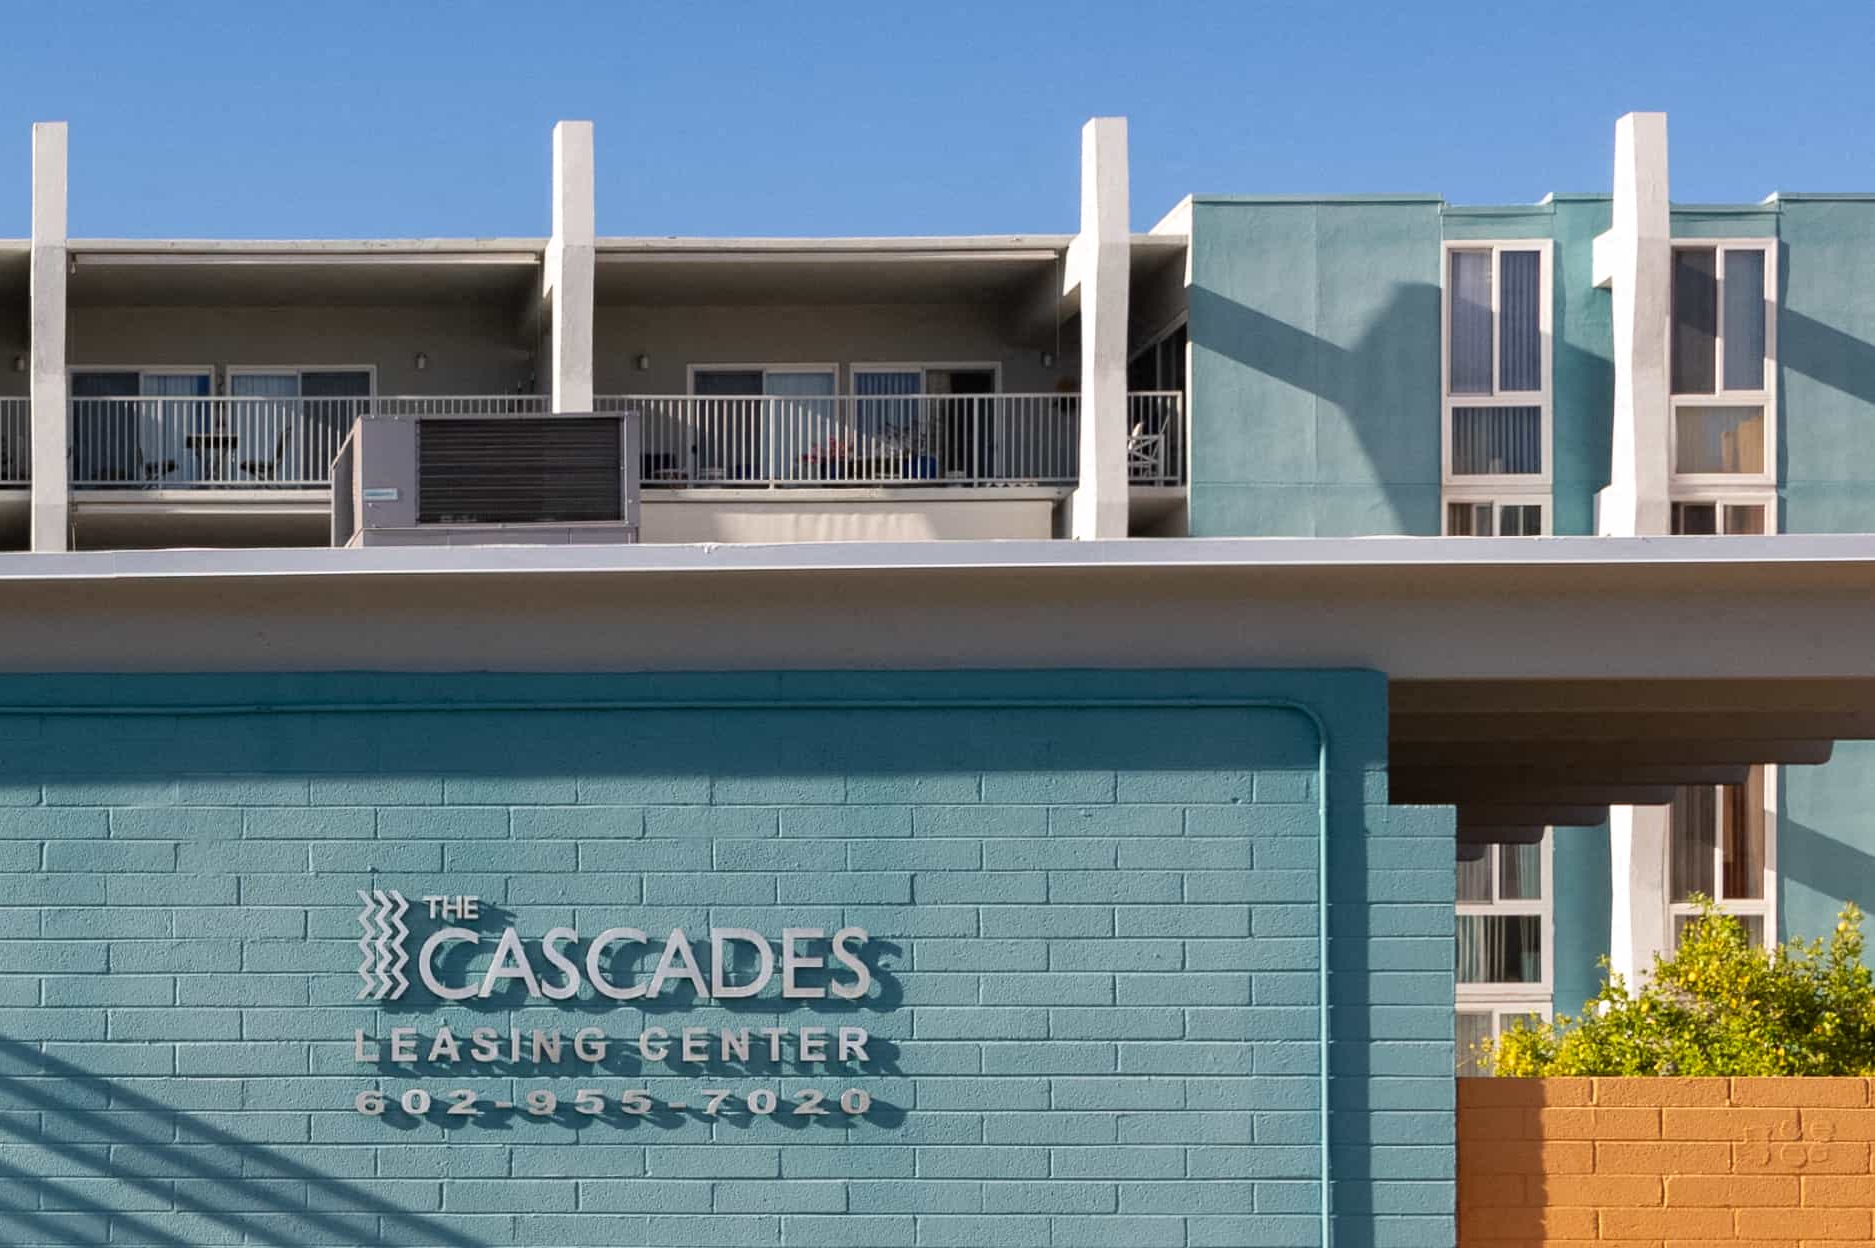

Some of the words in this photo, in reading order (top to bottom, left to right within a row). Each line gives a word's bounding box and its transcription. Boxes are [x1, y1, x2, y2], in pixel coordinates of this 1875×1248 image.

[425, 895, 479, 920] THE
[418, 927, 870, 1000] CASCADES
[355, 1027, 607, 1063] LEASING
[639, 1027, 871, 1062] CENTER
[355, 1088, 872, 1116] 602-955-7020
